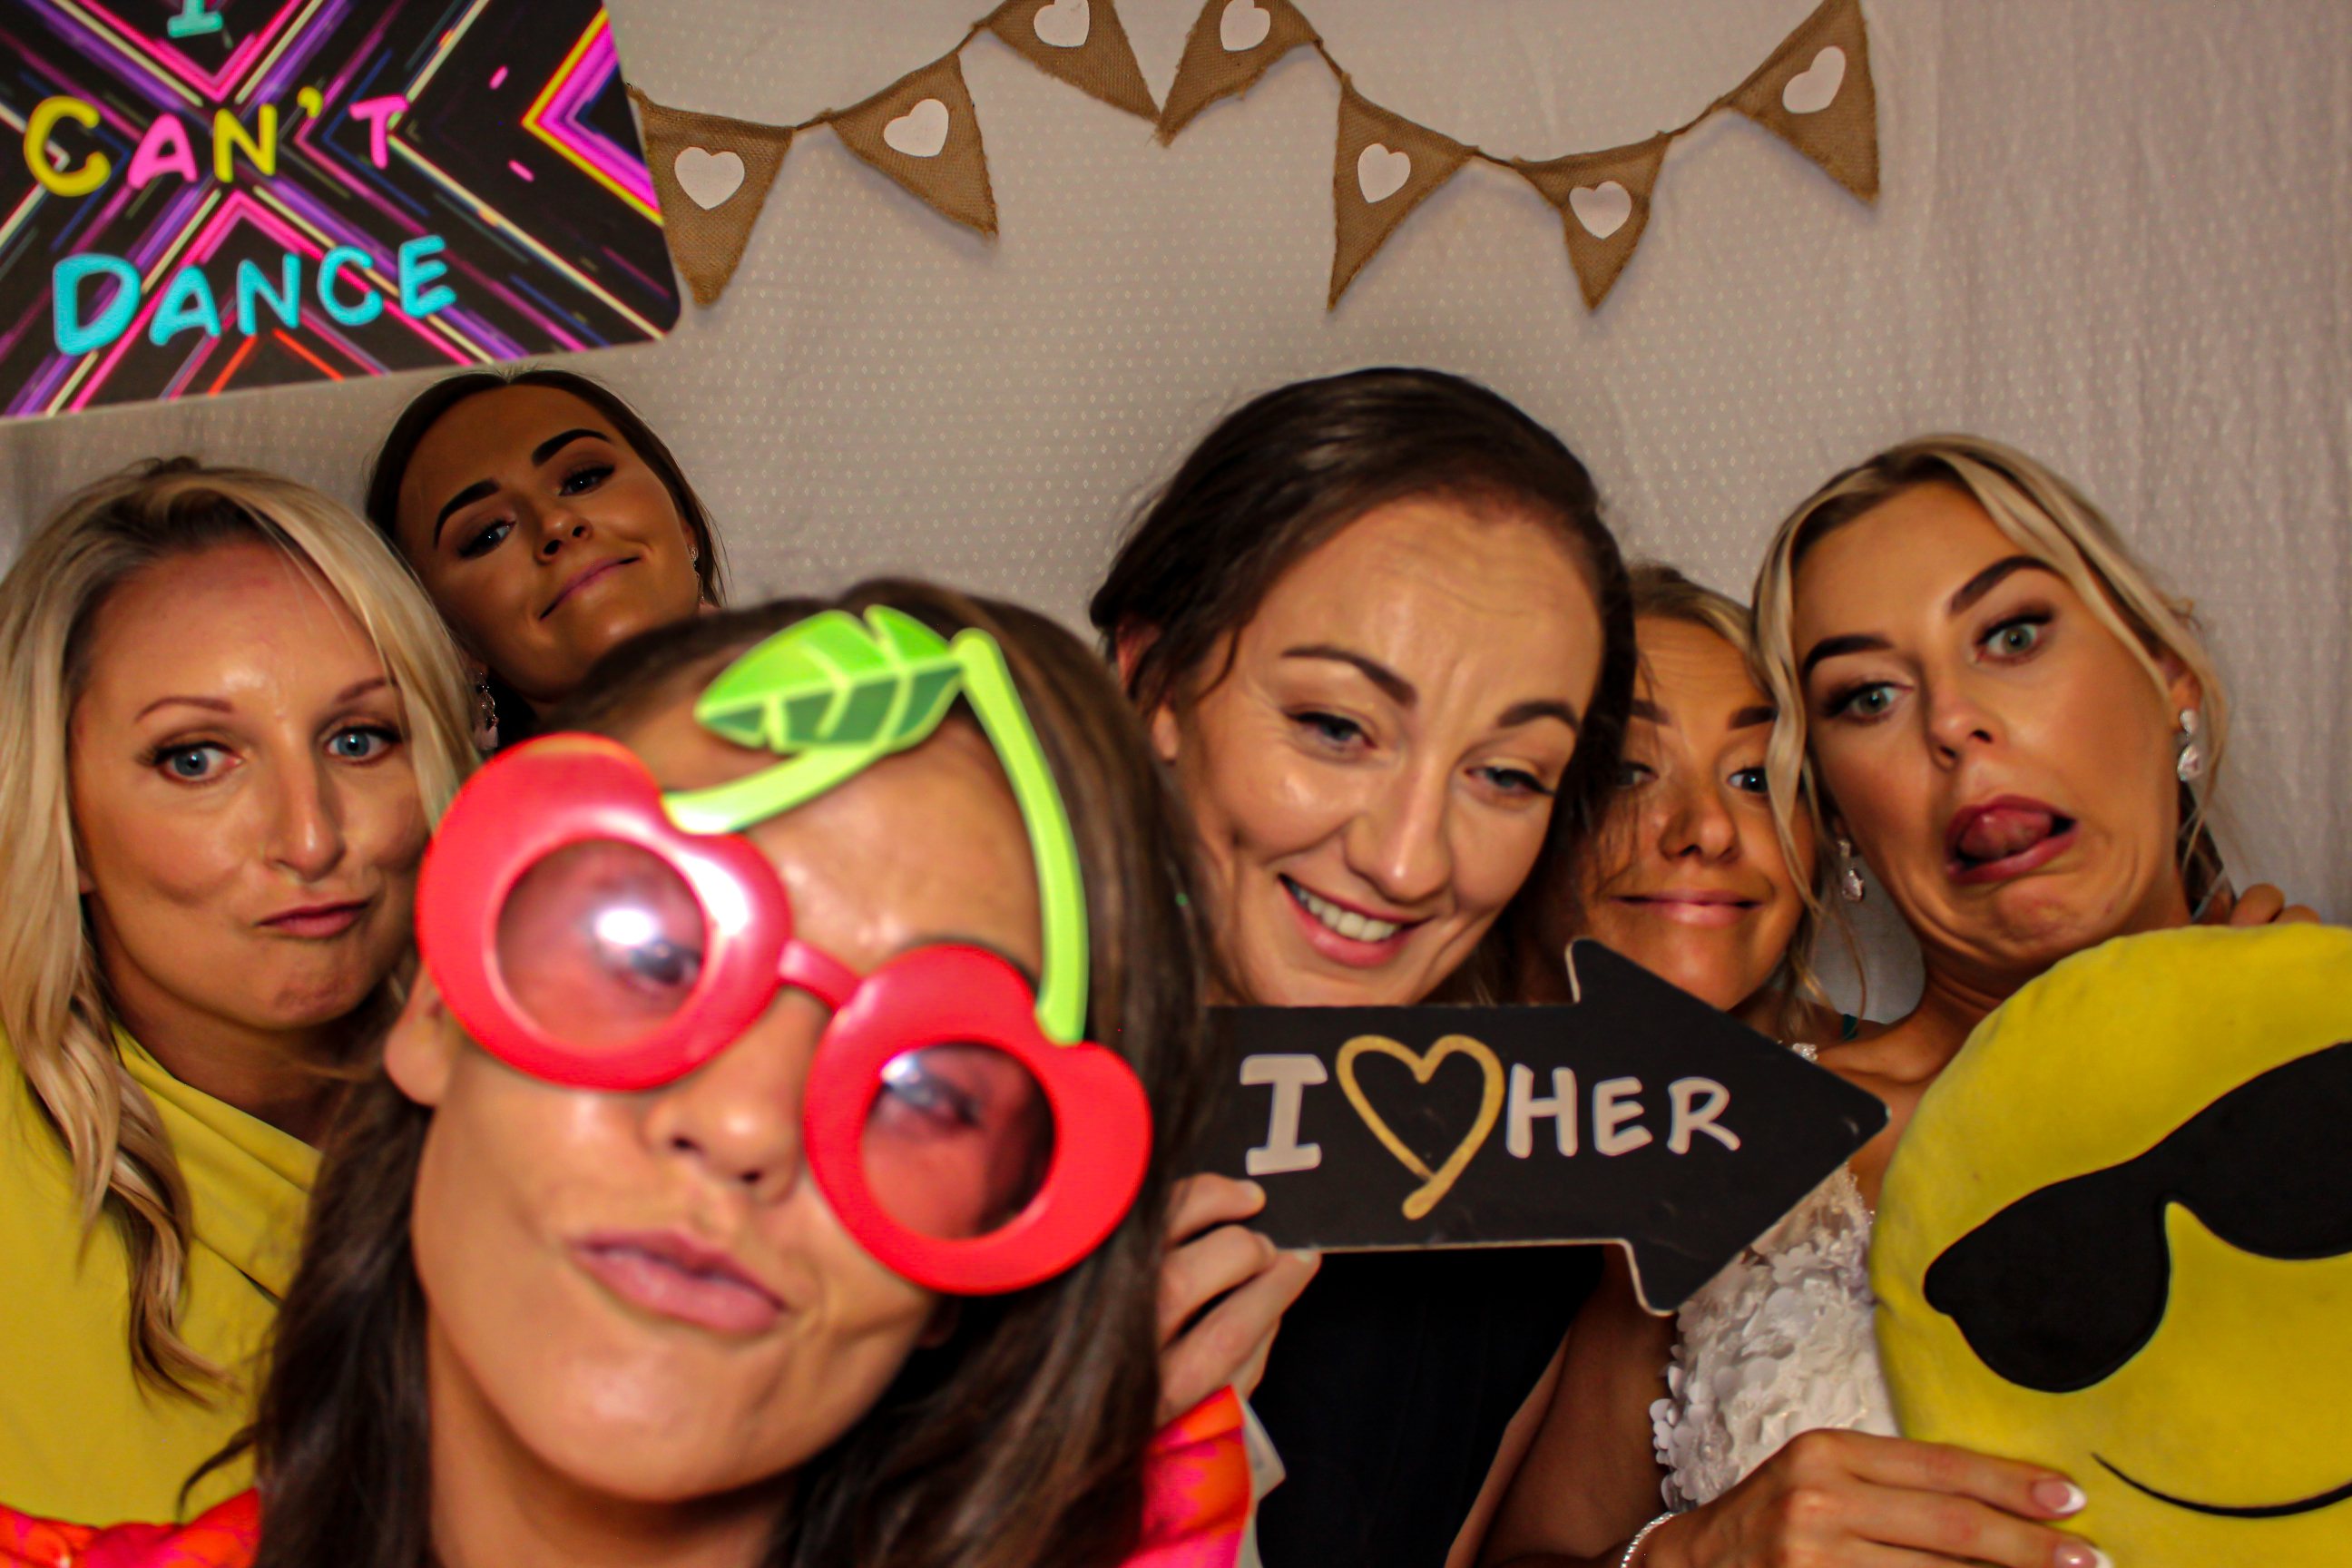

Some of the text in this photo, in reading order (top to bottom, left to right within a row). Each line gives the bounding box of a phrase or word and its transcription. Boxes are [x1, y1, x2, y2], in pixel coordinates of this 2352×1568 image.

[24, 88, 408, 196] CAN'T
[54, 236, 456, 355] DANCE
[1240, 1054, 1740, 1175] I HER
